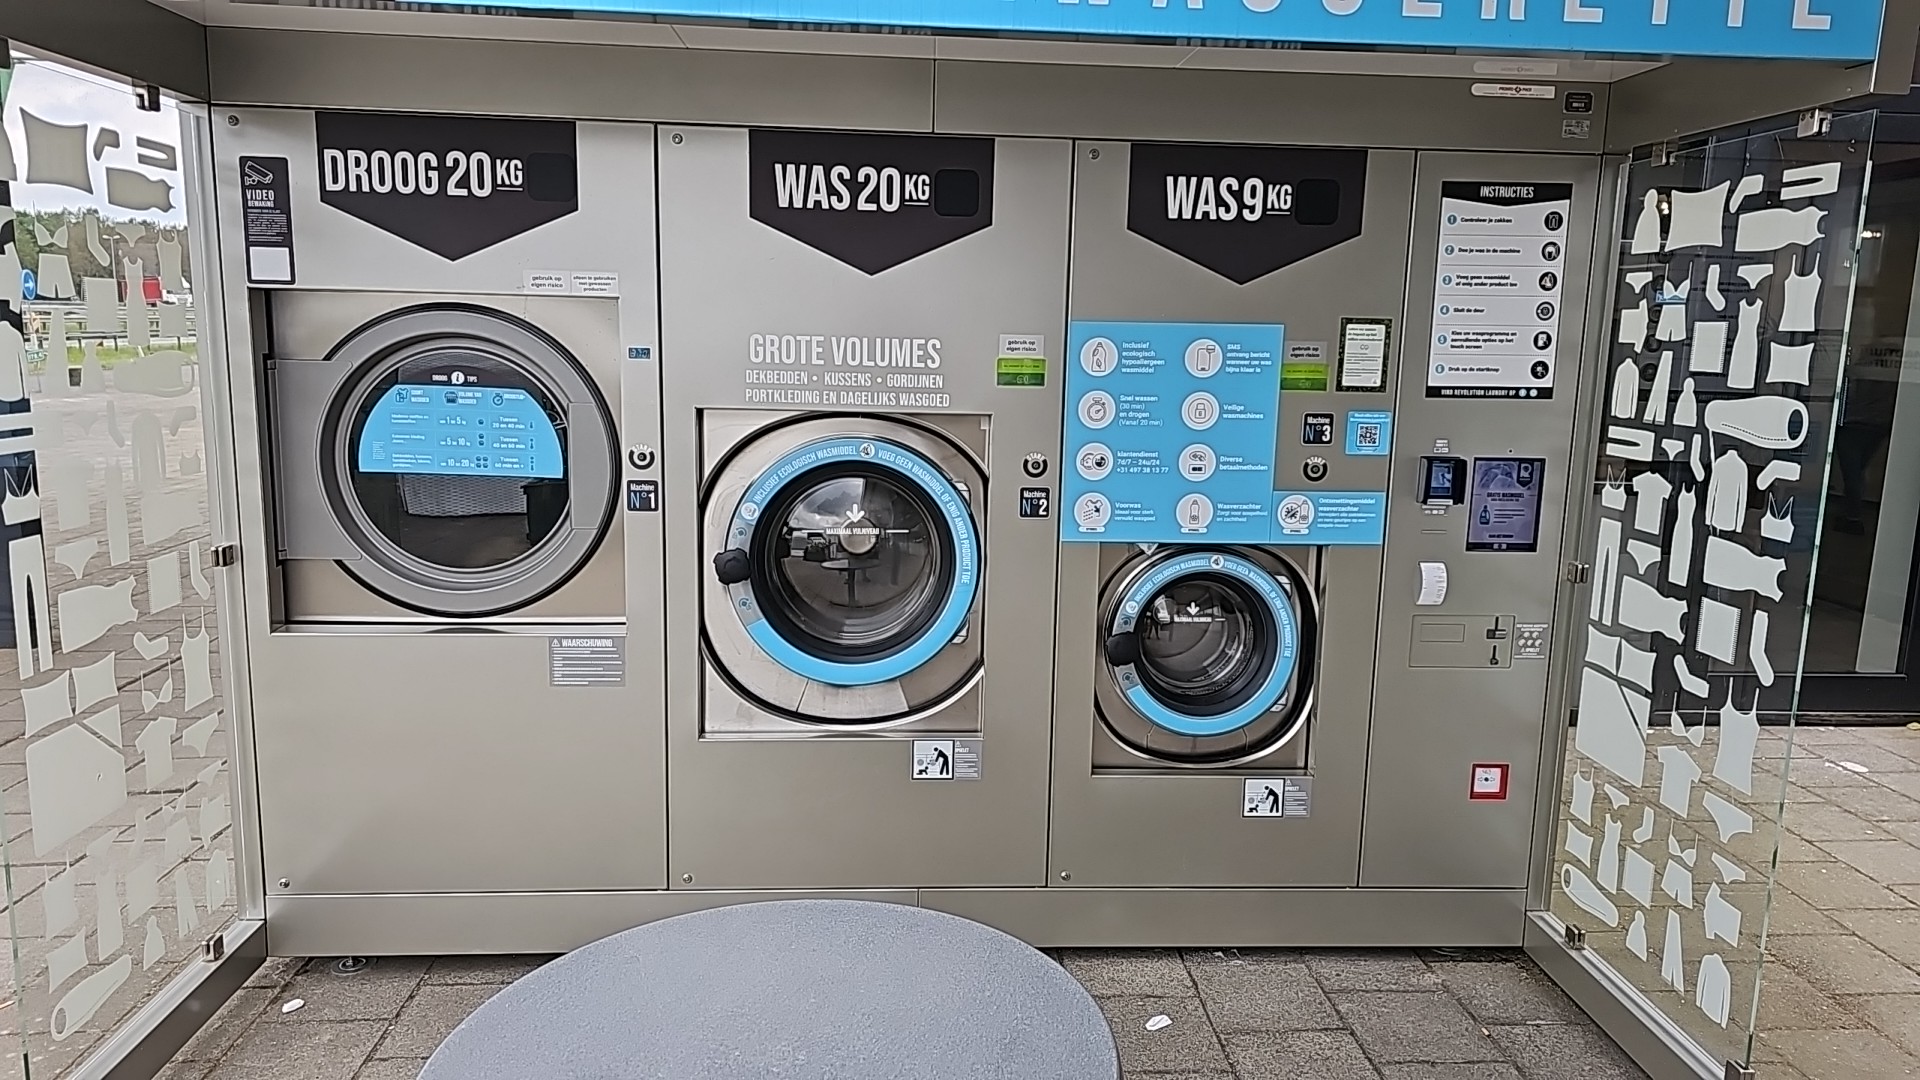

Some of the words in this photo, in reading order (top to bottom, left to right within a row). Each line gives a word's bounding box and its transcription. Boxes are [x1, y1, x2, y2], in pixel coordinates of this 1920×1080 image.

[323, 149, 439, 195] DROOG
[445, 151, 493, 198] 20
[496, 159, 524, 187] KG
[246, 189, 275, 200] VIDEO
[774, 163, 850, 210] WAS
[857, 166, 900, 212] 20
[904, 174, 930, 201] KG
[1480, 186, 1534, 198] INSTRUCTIES
[1166, 176, 1239, 221] WAS
[1242, 177, 1264, 222] 9
[1266, 184, 1293, 210] KG
[750, 333, 825, 366] GROTE
[831, 336, 941, 369] VOLUMES
[1122, 341, 1150, 349] Inclusief
[1122, 350, 1156, 358] ecologisch
[745, 369, 808, 386] DEKBEDDEN
[824, 371, 871, 388] KUSSENS
[886, 373, 943, 389] GORDIJNEN
[745, 389, 820, 405] PORTKLEDING
[823, 391, 837, 406] EN
[840, 391, 896, 406] DAGELIJKS
[899, 393, 950, 408] WASGOED
[1307, 416, 1330, 424] Machine
[631, 444, 652, 453] START
[878, 449, 896, 462] VOEG
[895, 455, 913, 470] GEEN
[1307, 456, 1326, 465] START
[753, 473, 780, 504] INCLUSIEF
[777, 451, 817, 479] ECOLOGISCH
[816, 445, 858, 460] WASMIDDEL
[911, 464, 943, 497] WASMIDDEL
[630, 483, 655, 491] Machine
[1024, 490, 1047, 498] Machine
[941, 493, 952, 506] OF
[947, 498, 960, 519] ENIG
[954, 516, 969, 540] ANDER
[961, 538, 972, 571] PRODUCT
[961, 570, 971, 585] TOE
[1134, 580, 1154, 602] INCLUSIEF
[1152, 564, 1181, 584] ECOLOGISCH
[1180, 558, 1210, 570] WASMIDDEL
[1224, 560, 1238, 570] VOEG
[1236, 565, 1249, 576] GEEN
[1248, 570, 1273, 594] WASMIDDEL
[1284, 624, 1292, 649] PRODUCT
[561, 638, 613, 648] WAARSCHUWING
